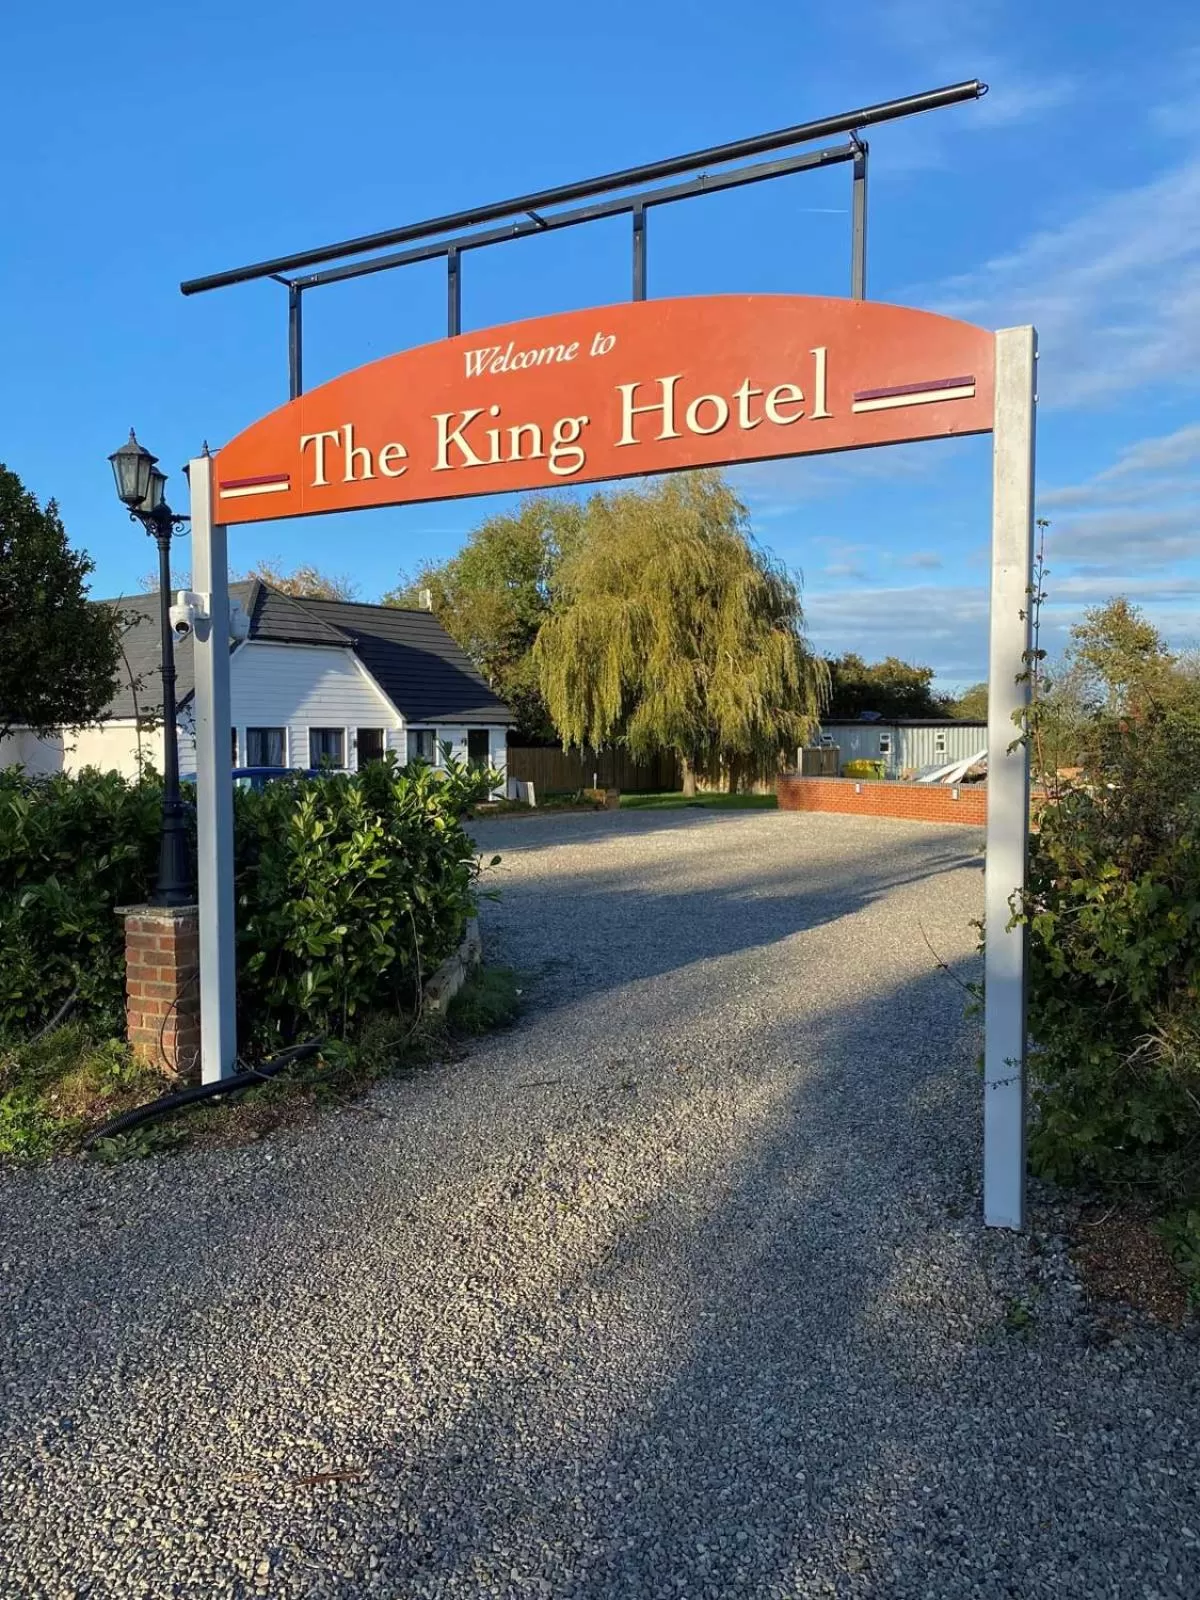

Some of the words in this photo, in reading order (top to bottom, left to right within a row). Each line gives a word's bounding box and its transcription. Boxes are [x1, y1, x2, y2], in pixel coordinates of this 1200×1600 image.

[463, 341, 580, 379] Welcome
[590, 331, 616, 356] to
[300, 423, 408, 487] The
[430, 405, 589, 475] King
[613, 346, 833, 447] Hotel
